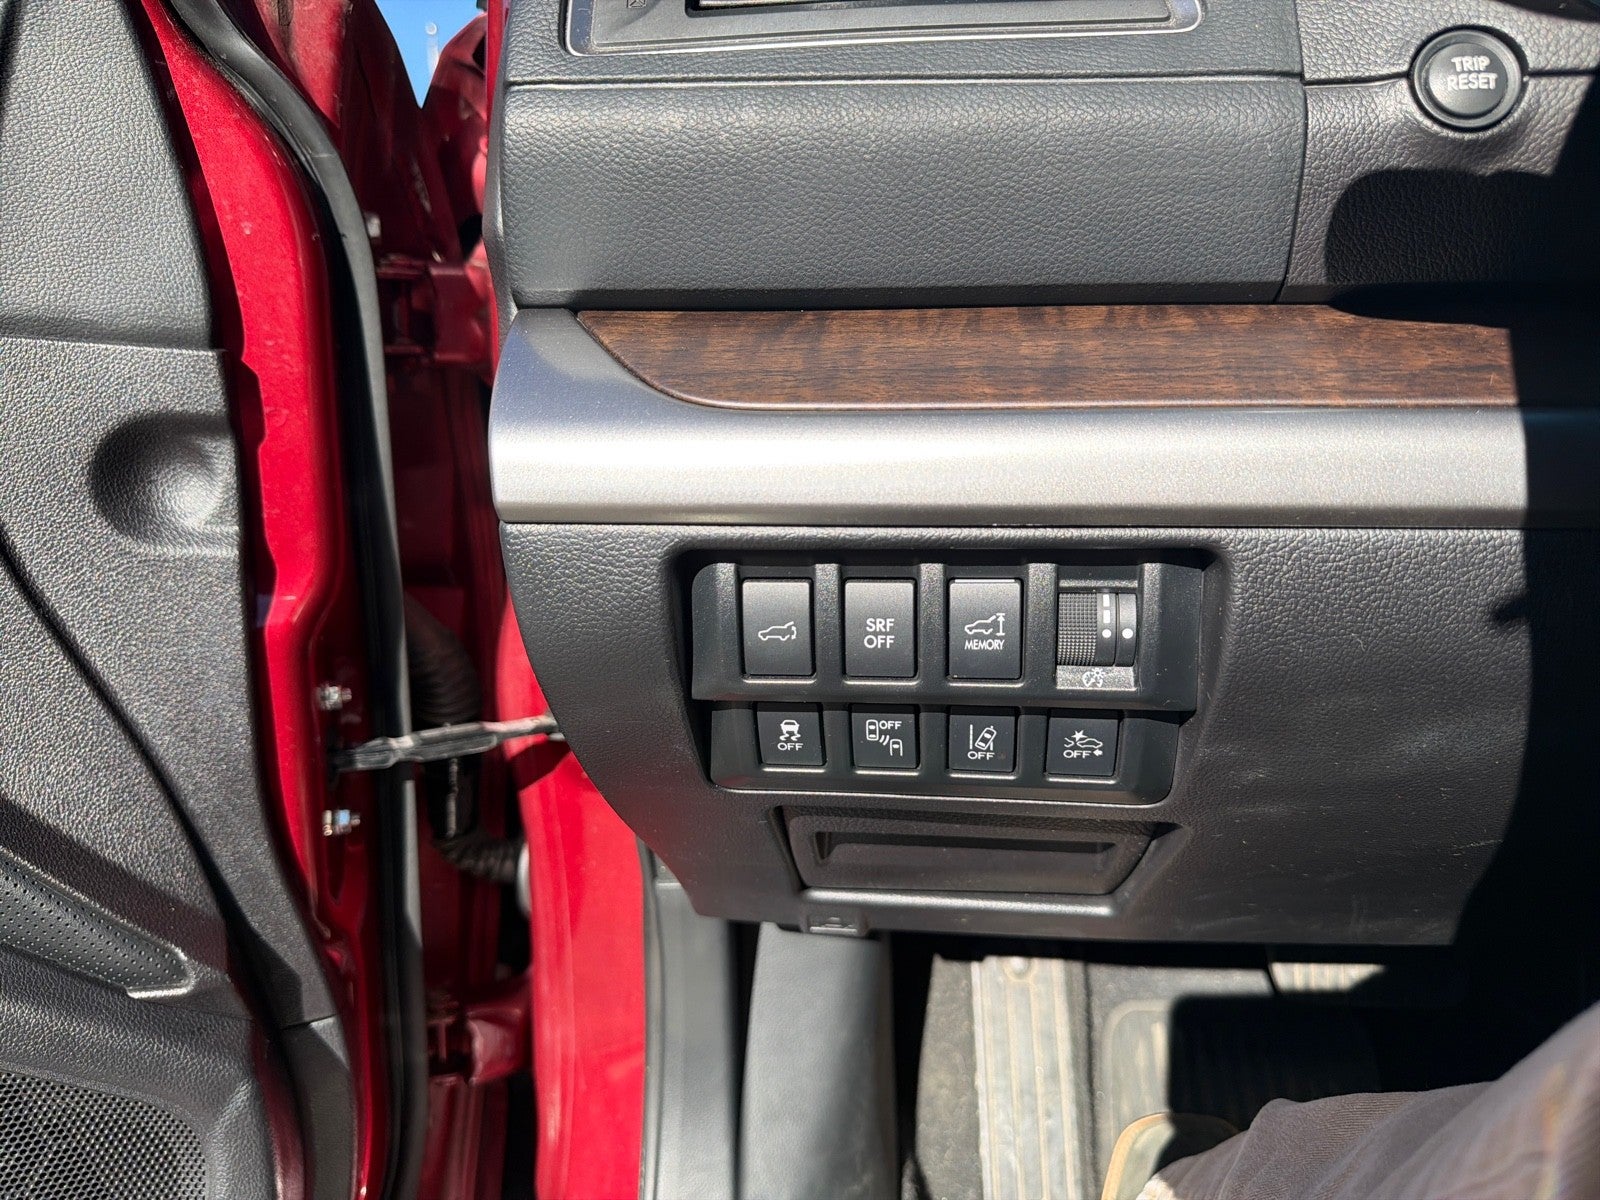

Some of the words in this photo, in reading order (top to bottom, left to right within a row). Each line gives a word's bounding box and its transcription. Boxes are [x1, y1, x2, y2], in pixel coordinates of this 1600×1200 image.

[1451, 55, 1491, 72] TRIP
[1446, 72, 1498, 91] RESET
[865, 618, 895, 632] SRF
[863, 635, 895, 649] OFF
[964, 639, 1005, 651] MEMORY
[879, 720, 902, 730] OFF
[777, 742, 803, 751] OFF
[967, 751, 995, 760] OFF
[1063, 749, 1092, 759] OFF
